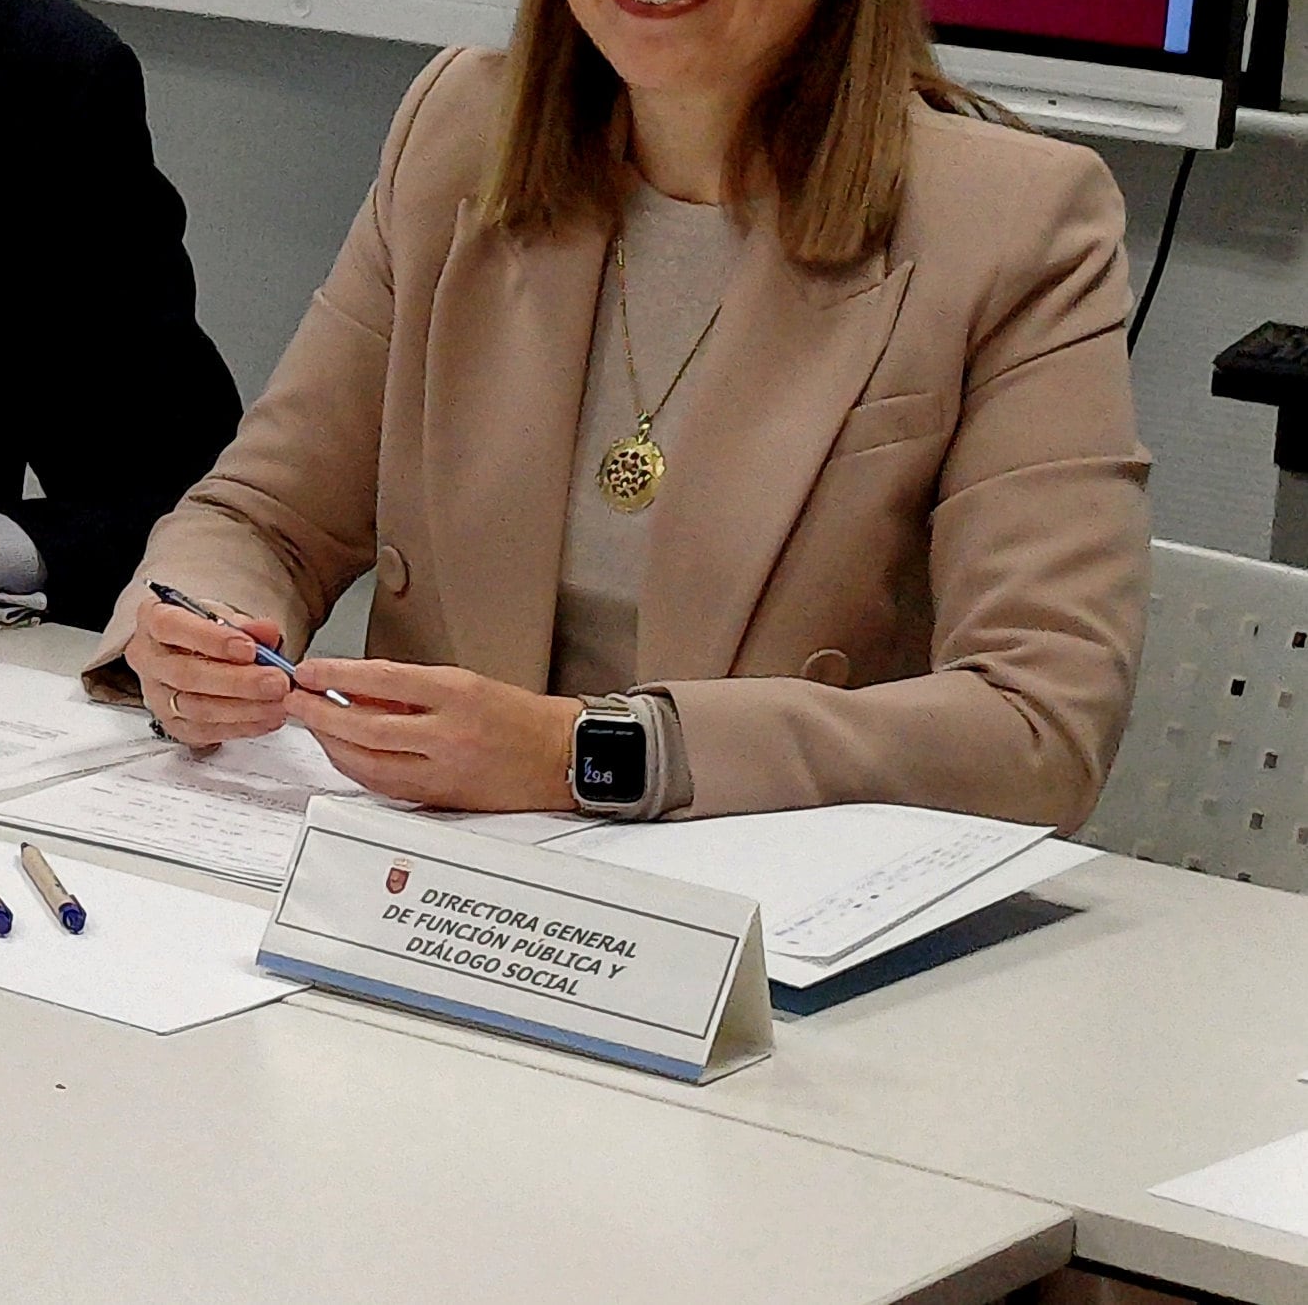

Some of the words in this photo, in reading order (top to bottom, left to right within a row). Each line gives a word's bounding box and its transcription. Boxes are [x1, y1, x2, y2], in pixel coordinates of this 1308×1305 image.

[382, 904, 412, 925] DE
[413, 912, 510, 950] FUNCIÓN
[510, 932, 604, 977] PÚBLICA
[606, 964, 627, 980] Y
[420, 888, 541, 932] DIRECTORA
[542, 920, 639, 959] GENERAL
[405, 934, 501, 975] DIÁLOGO
[500, 962, 580, 996] SOCIAL
